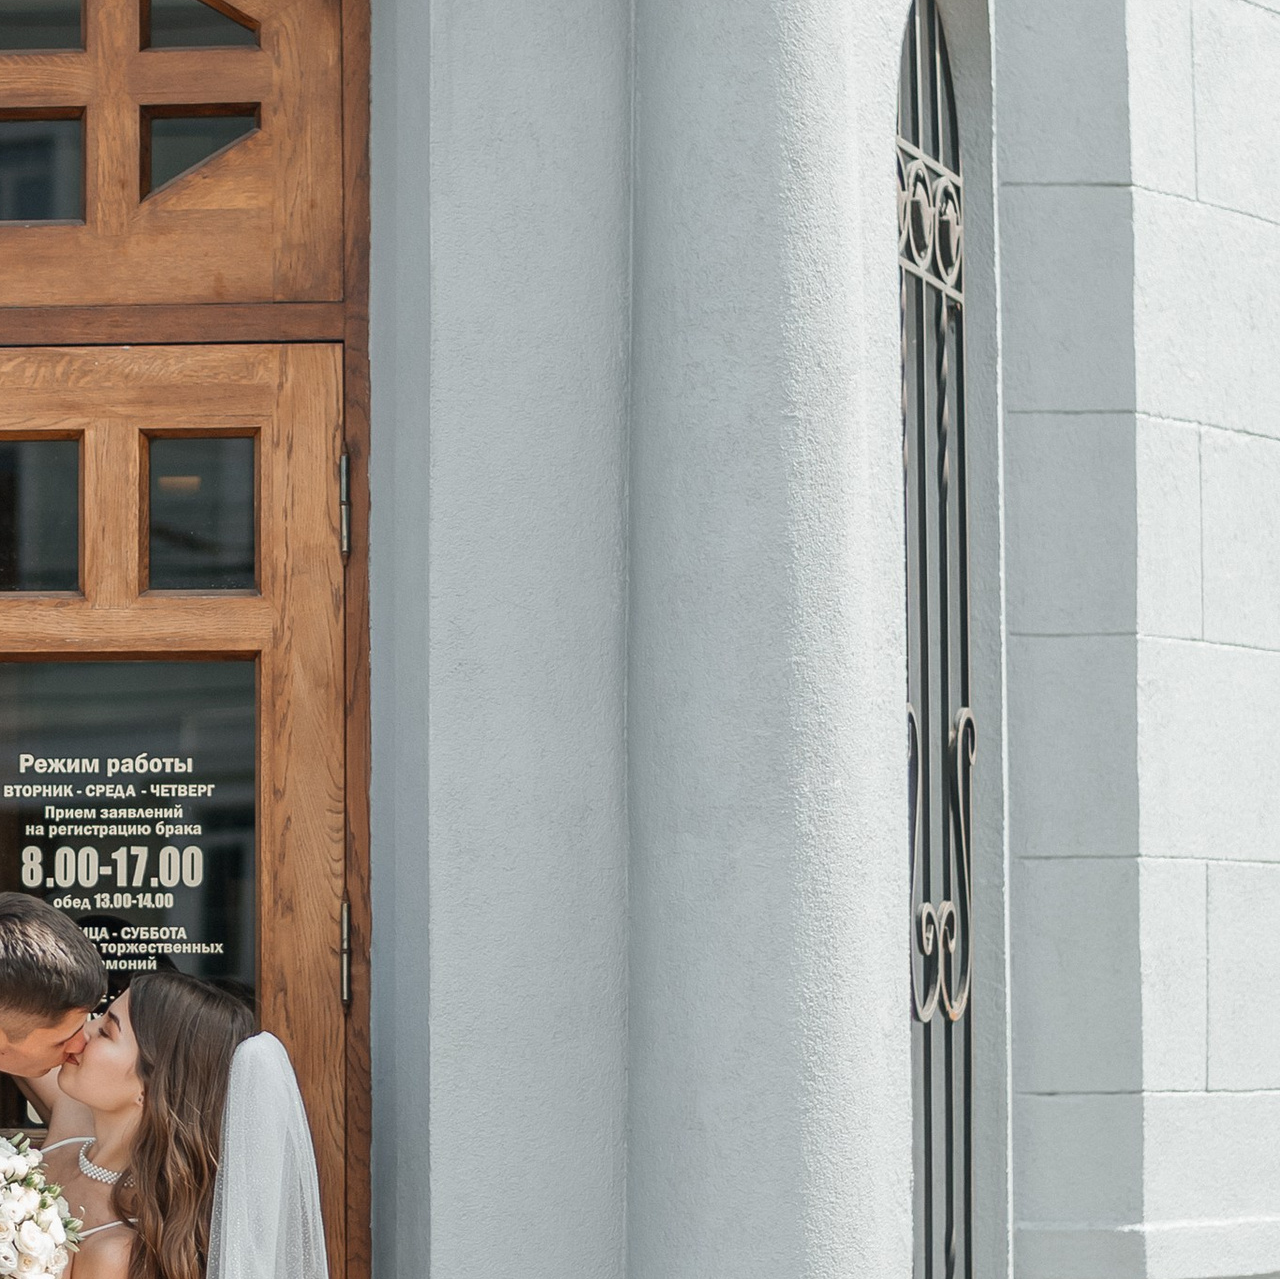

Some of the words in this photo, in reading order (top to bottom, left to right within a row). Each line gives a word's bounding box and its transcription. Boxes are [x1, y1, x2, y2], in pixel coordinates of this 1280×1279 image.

[19, 754, 99, 773] Режим
[107, 753, 193, 777] работы
[3, 785, 73, 797] ВТОРНИК
[85, 785, 136, 798] СРЕДА
[150, 785, 215, 797] ЧЕТВЕРГ
[45, 806, 96, 821] Прием
[100, 805, 183, 819] заявлений
[25, 825, 44, 835] на
[49, 824, 151, 838] регистрацию
[155, 821, 202, 836] брака
[21, 846, 204, 888] 8.00-17.00
[53, 895, 91, 910] обед
[94, 893, 174, 908] 13.00-14.00
[121, 927, 187, 939] СУББОТА
[100, 943, 223, 957] торжественных
